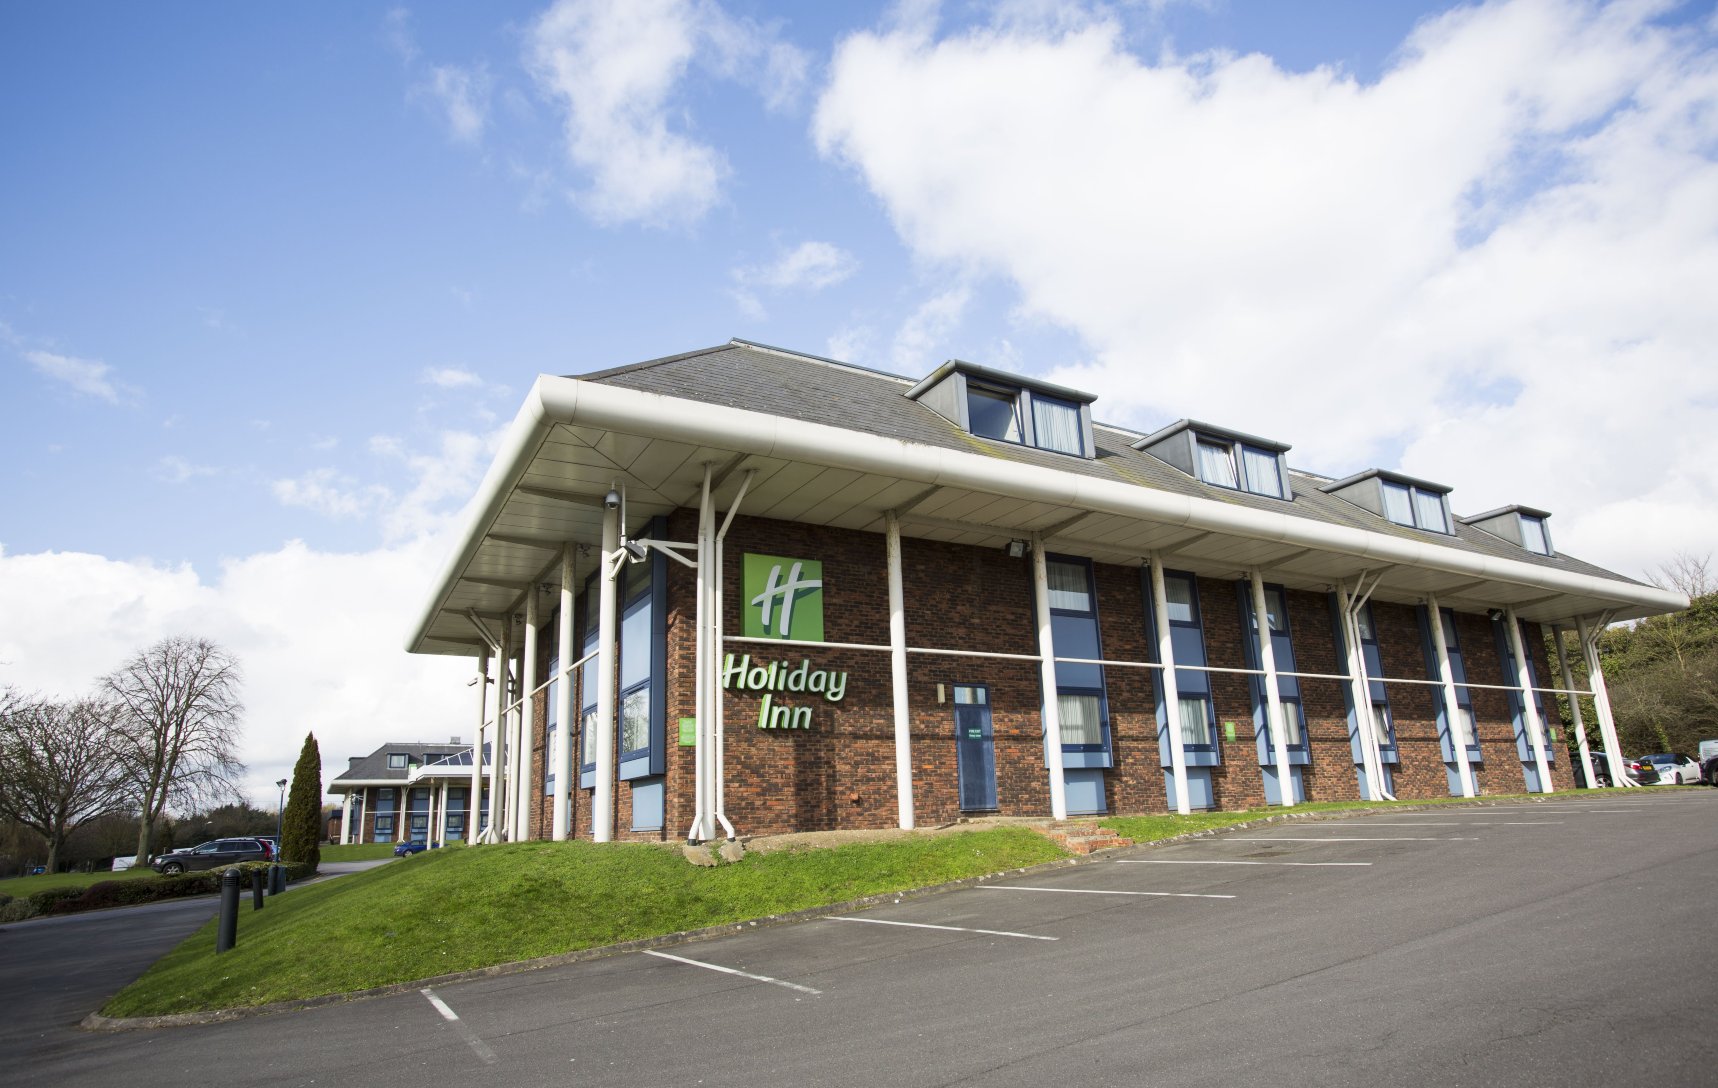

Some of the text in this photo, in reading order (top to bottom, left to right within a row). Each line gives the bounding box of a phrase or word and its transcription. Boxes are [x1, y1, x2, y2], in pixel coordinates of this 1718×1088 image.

[751, 562, 823, 636] H
[722, 653, 847, 701] Holiday
[758, 693, 812, 729] Inn
